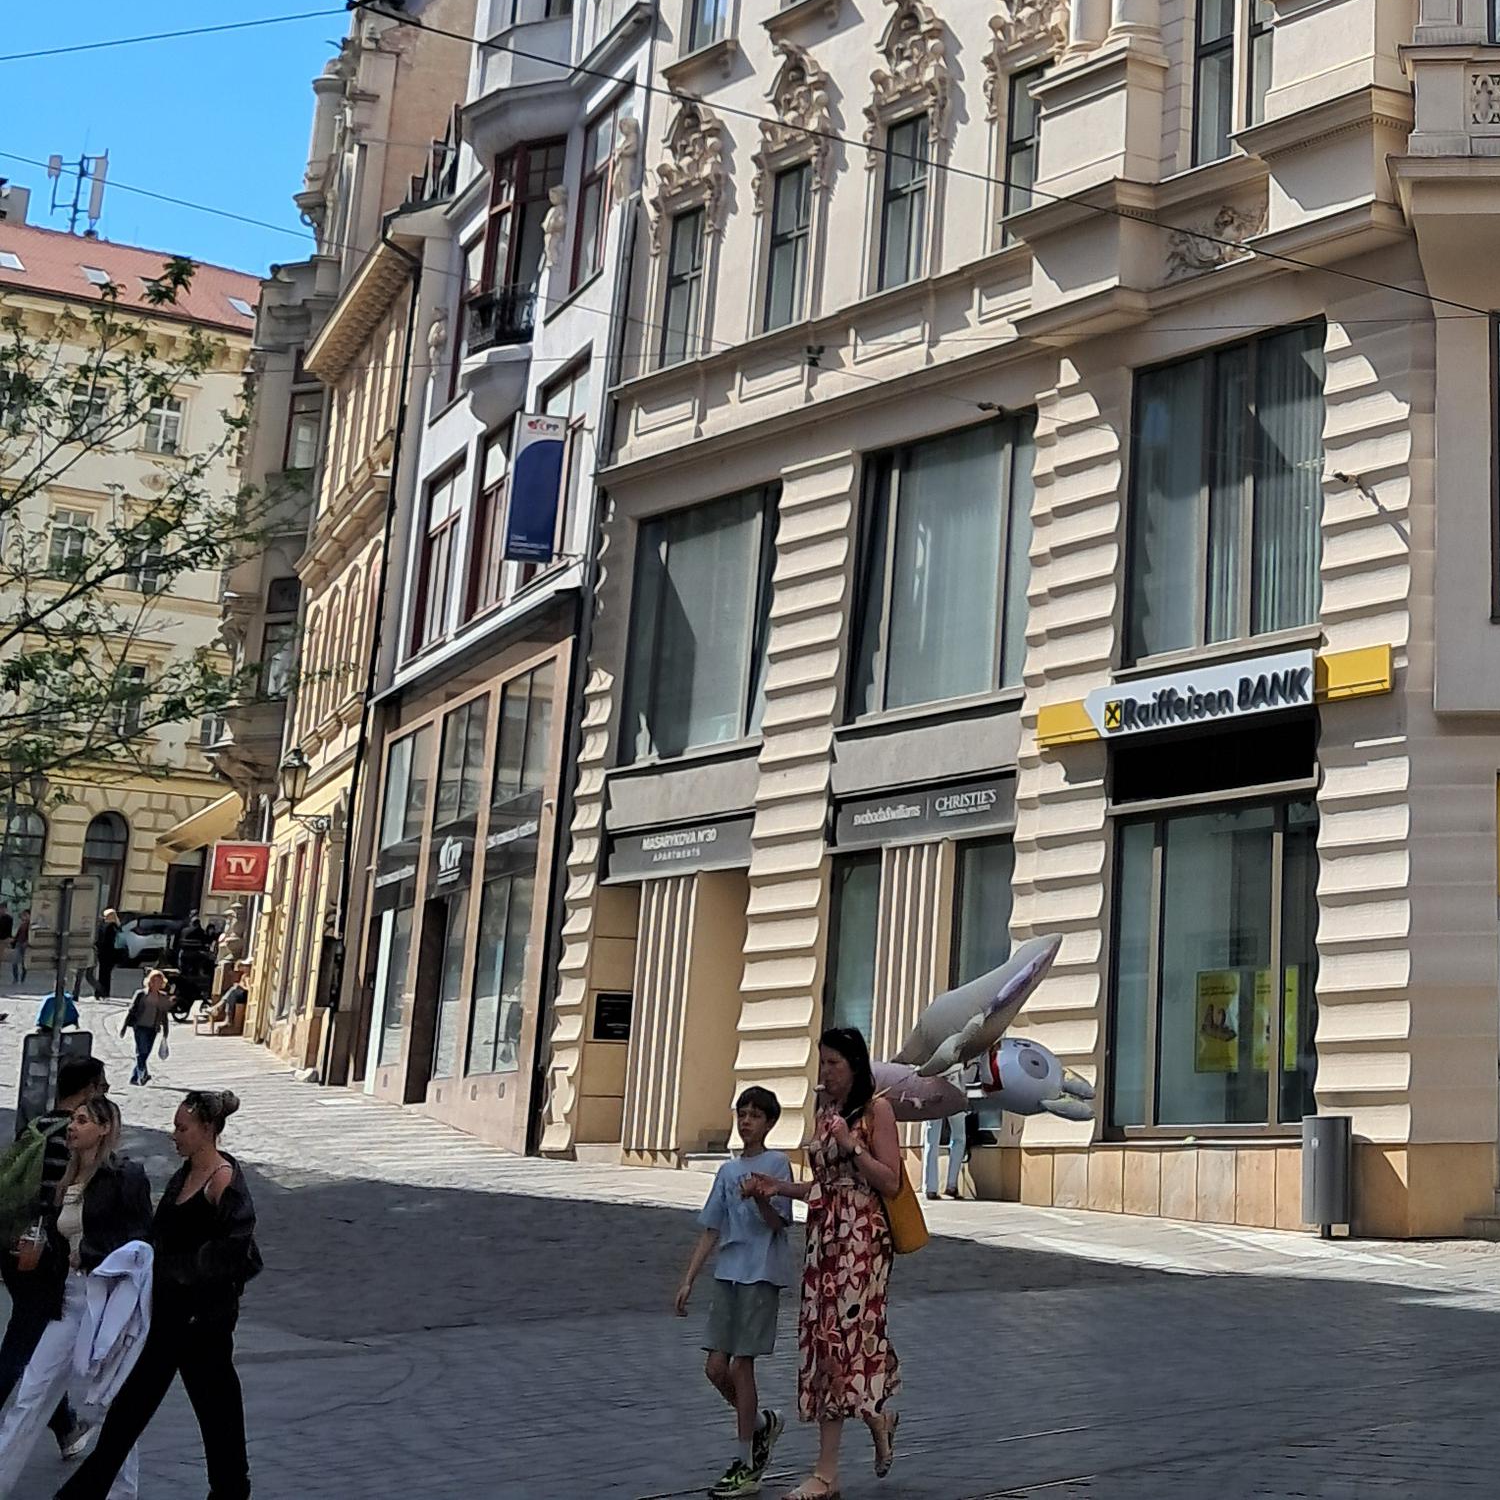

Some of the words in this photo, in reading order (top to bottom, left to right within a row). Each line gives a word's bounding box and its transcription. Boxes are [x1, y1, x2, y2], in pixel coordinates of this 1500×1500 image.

[1124, 685, 1234, 731] Raiffeisen
[1237, 667, 1312, 711] BANK
[935, 789, 997, 811] CHRISTIE'S
[652, 848, 701, 861] APARTMENTS
[226, 856, 257, 875] TV
